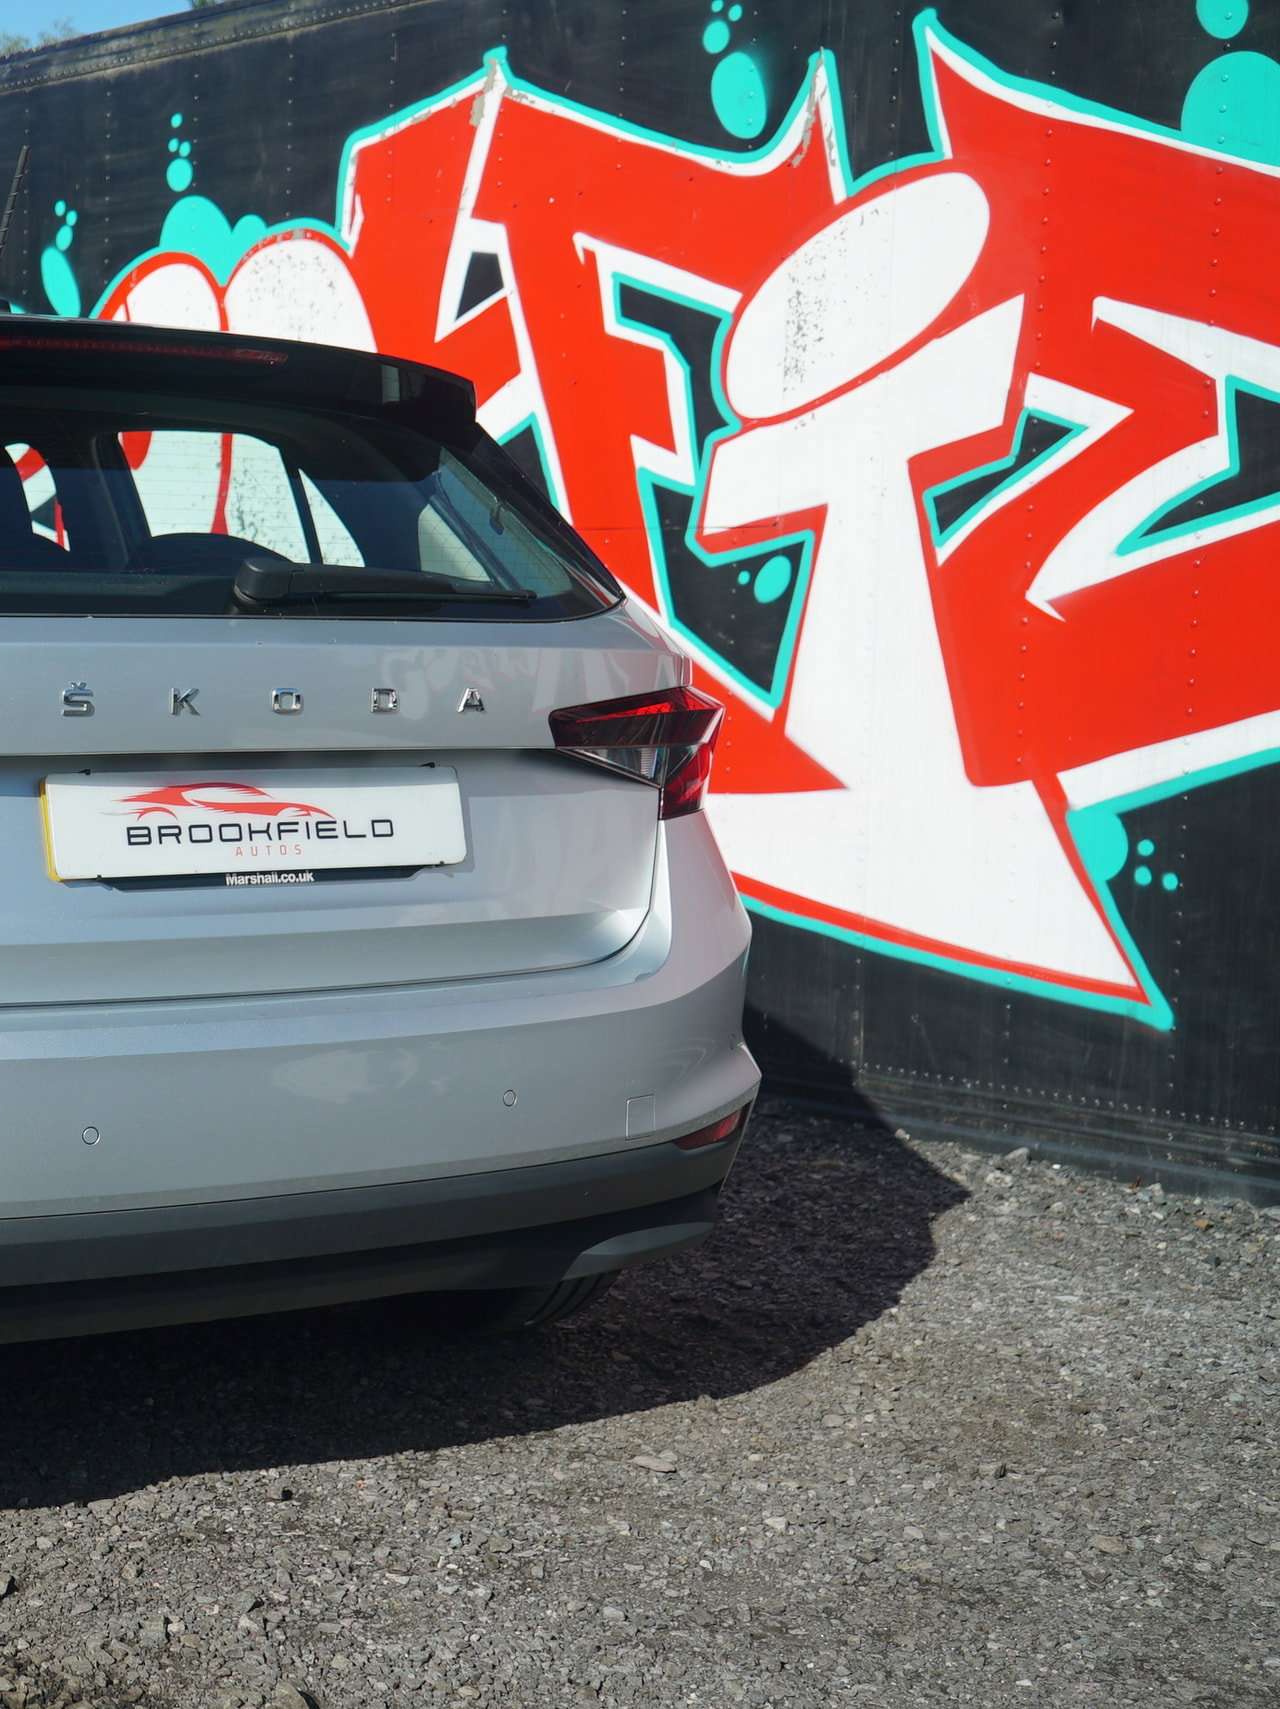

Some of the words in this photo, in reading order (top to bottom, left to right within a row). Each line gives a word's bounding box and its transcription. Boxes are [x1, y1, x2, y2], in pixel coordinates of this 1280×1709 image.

[61, 682, 487, 717] ŠKODA
[126, 819, 395, 846] BROOKFIELD
[235, 844, 303, 857] AUTOS
[225, 870, 315, 886] Marshall.co.uk
